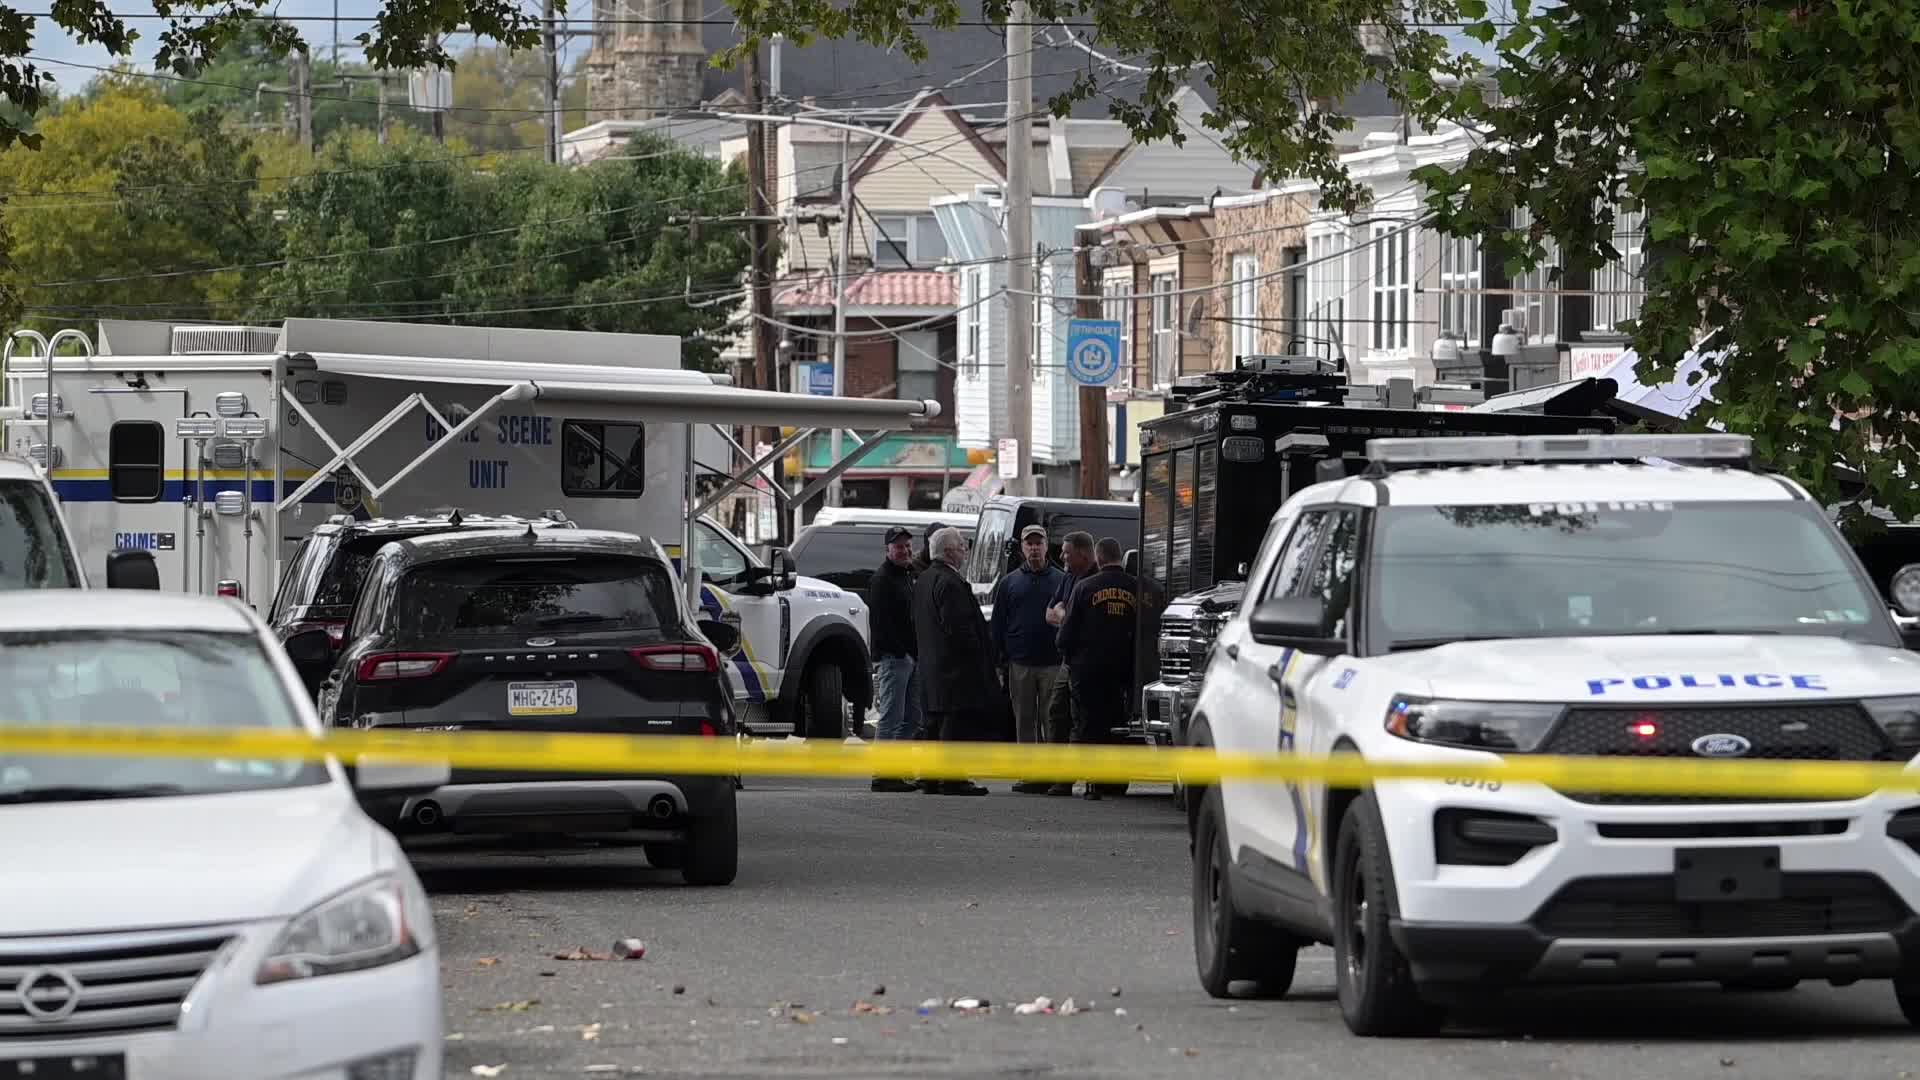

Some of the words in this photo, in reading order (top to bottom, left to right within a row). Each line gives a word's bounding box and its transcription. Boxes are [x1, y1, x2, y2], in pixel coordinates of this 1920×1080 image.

[498, 415, 552, 445] SCENE
[469, 459, 508, 489] UNIT
[115, 532, 157, 550] CRIME
[1107, 601, 1126, 616] UNIT
[1586, 673, 1828, 696] POLICE
